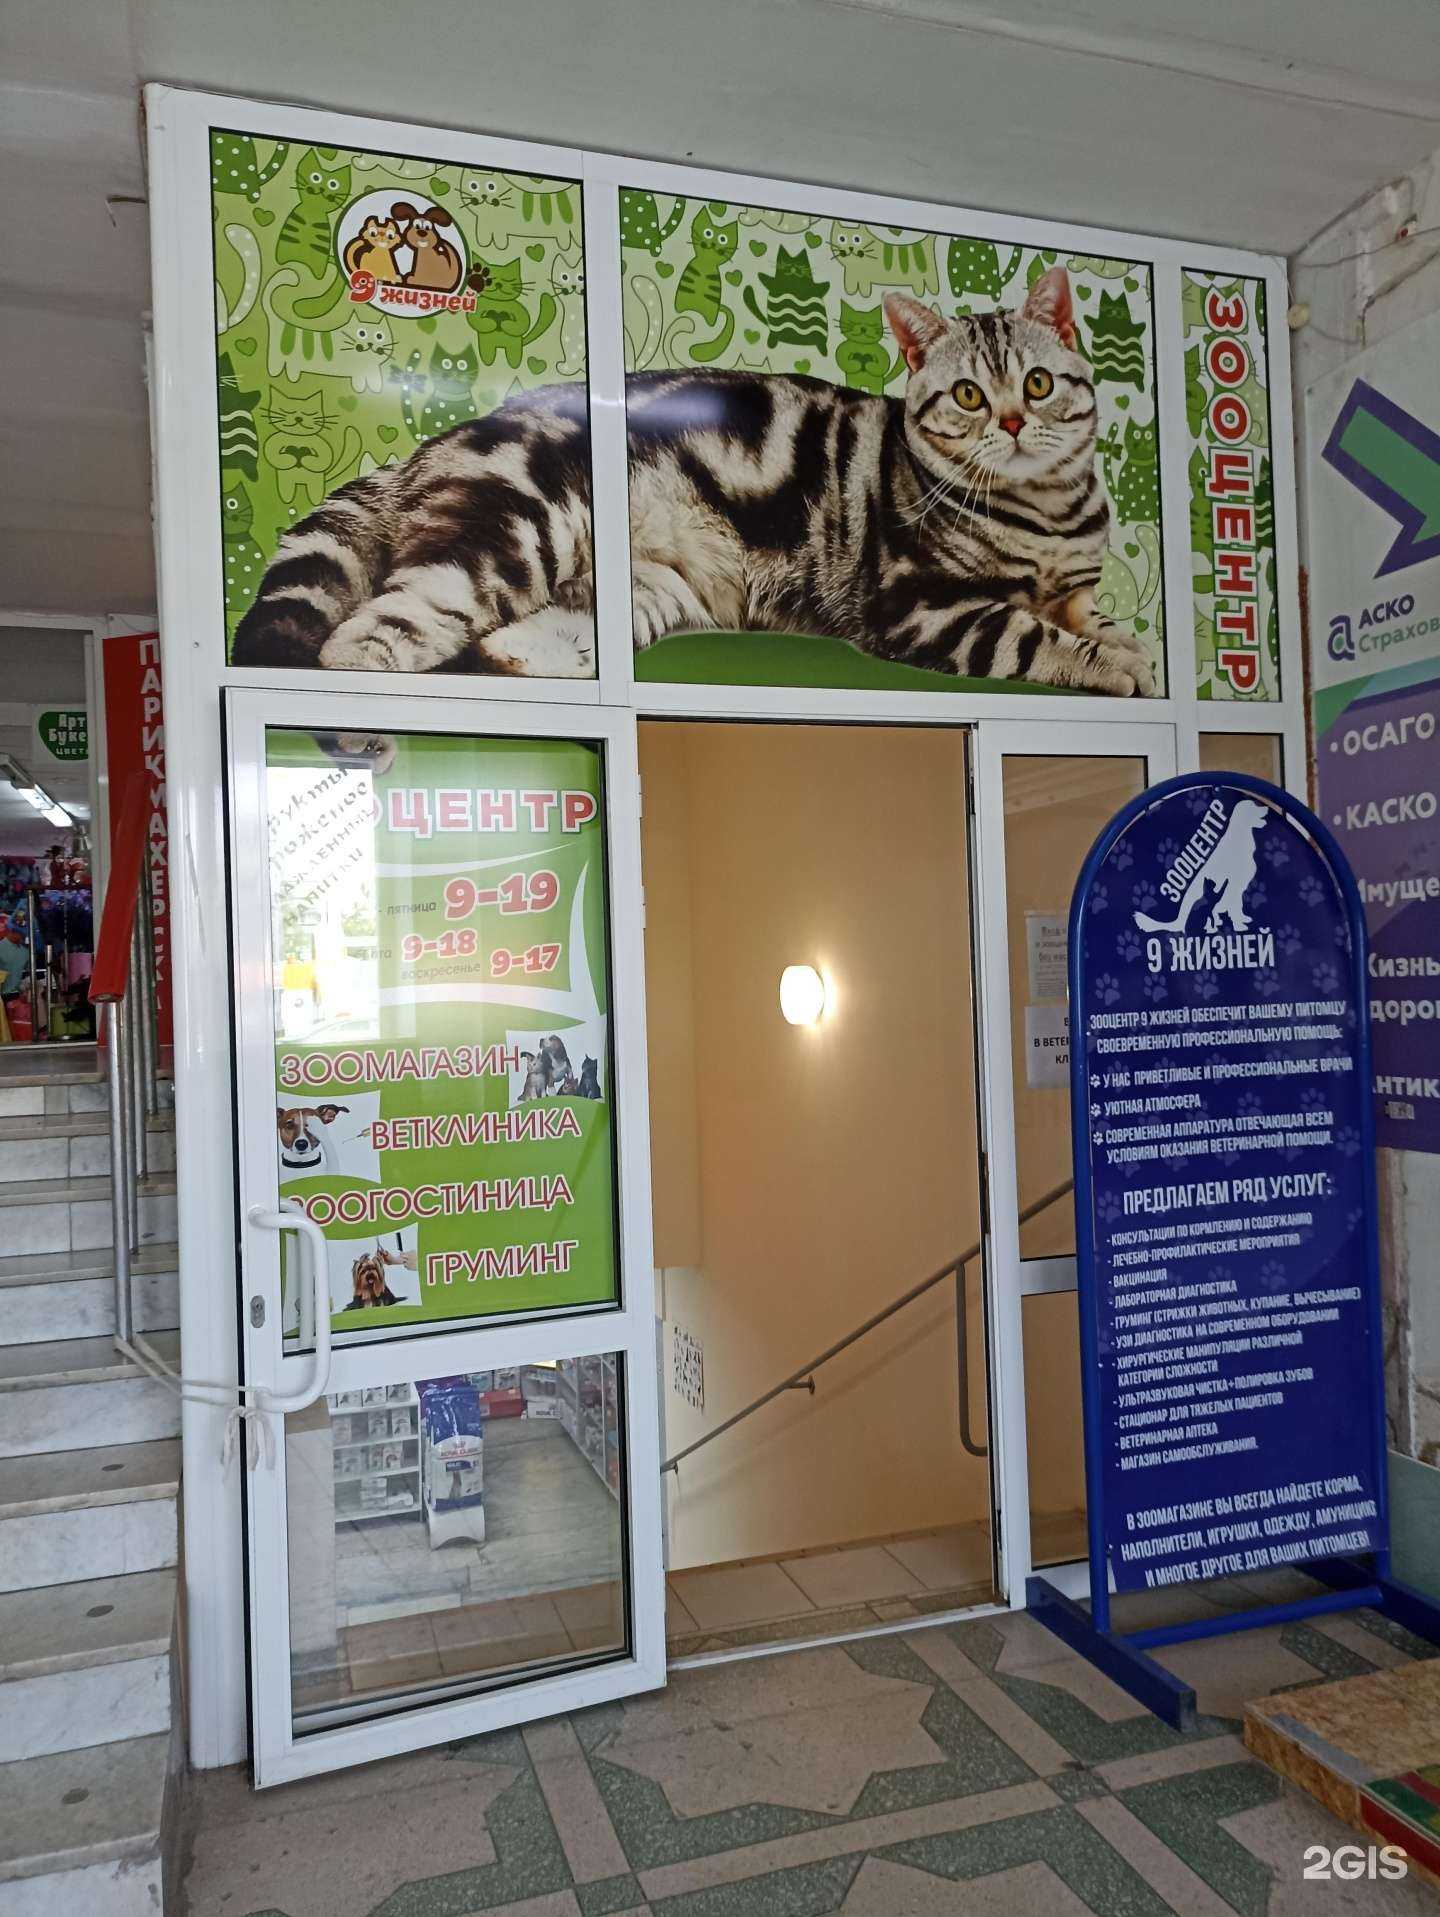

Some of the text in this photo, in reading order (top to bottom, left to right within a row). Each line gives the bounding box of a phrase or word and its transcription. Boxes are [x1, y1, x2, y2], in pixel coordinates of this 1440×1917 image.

[349, 269, 477, 313] 9 жизней
[1205, 285, 1261, 694] ЗООЦЕНТР
[1358, 594, 1415, 630] АСКО
[1343, 712, 1436, 756] ОСАГО
[374, 787, 598, 838] ЦЕНТР
[1346, 792, 1437, 830] КАСКО
[1161, 799, 1230, 903] ЗООЦЕНТР
[387, 901, 437, 916] пятница
[1147, 927, 1275, 972] 9 ЖИЗНЕЙ
[401, 963, 481, 980] воскресенье
[1090, 1000, 1346, 1029] ЗООЦЕНТР 9 ЖИЗНЕЙ ОБЕСПЕЧИТ ВАШЕМУ ПИТОМЦУ
[1097, 1033, 1181, 1054] СВОЕВРЕМЕННУЮ
[1182, 1026, 1292, 1047] ПРОФЕССИОНАЛЬНУЮ
[280, 1045, 520, 1086] ЗООМАГАЗИН
[1102, 1056, 1353, 1088] У НАС ПРИВЕТЛИВЫЕ И ПРОФЕССИОНАЛЬНЫЕ ВРАЧИ
[1104, 1093, 1201, 1116] УЮТНАЯ АТМОСФЕРА
[370, 1107, 582, 1150] ВЕТКЛИНИКА
[1105, 1111, 1334, 1144] СОВРЕМЕННАЯ АППАРАТУРА ОТВЕЧАЮЩАЯ ВСЕМ
[1107, 1145, 1159, 1164] УСЛОВИЯМ
[1160, 1139, 1209, 1158] ОКАЗАНИЯ
[1210, 1131, 1285, 1153] ВЕТЕРИНАРНОЙ
[1123, 1172, 1332, 1215] ПРЕДЛАГАЕМ РЯД УСЛУГ:
[1111, 1212, 1313, 1247] КОНСУЛЬТАЦИИ ПО КОРМЛЕНИЮ И СОДЕРЖАНИЮ
[426, 1239, 579, 1286] ГРУМИНГ
[1112, 1233, 1301, 1267] ЛЕЧЕБНО-ПРОФИЛАКТИЧЕСКИЕ МЕРОПРИЯТИЯ
[1113, 1268, 1167, 1288] ВАКЦИНАЦИЯ
[1114, 1280, 1238, 1308] ЛАБОРАТОРНАЯ ДИАГНОСТИКА
[1115, 1311, 1153, 1330] ГРУМИНГ
[1116, 1335, 1133, 1350] УЗИ
[1134, 1325, 1194, 1347] ДИАГНОСТИКА
[1195, 1323, 1208, 1337] НА
[1208, 1315, 1270, 1333] СОВРЕМЕННОМ
[1117, 1330, 1303, 1370] ХИРУРГИЧЕСКИЕ МАНИПУЛЯЦИИ РАЗЛИЧНОЙ
[1118, 1359, 1219, 1387] КАТЕГОРИИ СЛОЖНОСТИ
[1119, 1383, 1195, 1408] УЛЬТРАЗВУКОВАЯ
[1285, 1367, 1314, 1383] ЗУБОВ
[1119, 1391, 1284, 1429] СТАЦИОНАР ДЛЯ ТЯЖЕЛЫХ ПАЦИЕНТОВ
[1120, 1421, 1218, 1450] ВЕТЕРИНАРНАЯ АПТЕКА
[1121, 1451, 1162, 1471] МАГАЗИН
[1126, 1513, 1136, 1531] В
[1136, 1499, 1214, 1529] ЗООМАГАЗИНЕ
[1215, 1496, 1234, 1515] ВЫ
[1234, 1489, 1277, 1512] ВСЕГДА
[1275, 1482, 1324, 1504] НАЙДЕТЕ
[1121, 1530, 1207, 1562] НАПОЛНИТЕЛИ,
[1263, 1510, 1315, 1536] ОДЕЖДУ,
[1145, 1569, 1156, 1588] И
[1155, 1561, 1201, 1586] МНОГОЕ
[1200, 1552, 1245, 1579] ДРУГОЕ
[1244, 1549, 1271, 1571] ДЛЯ
[1269, 1541, 1310, 1564] ВАШИХ
